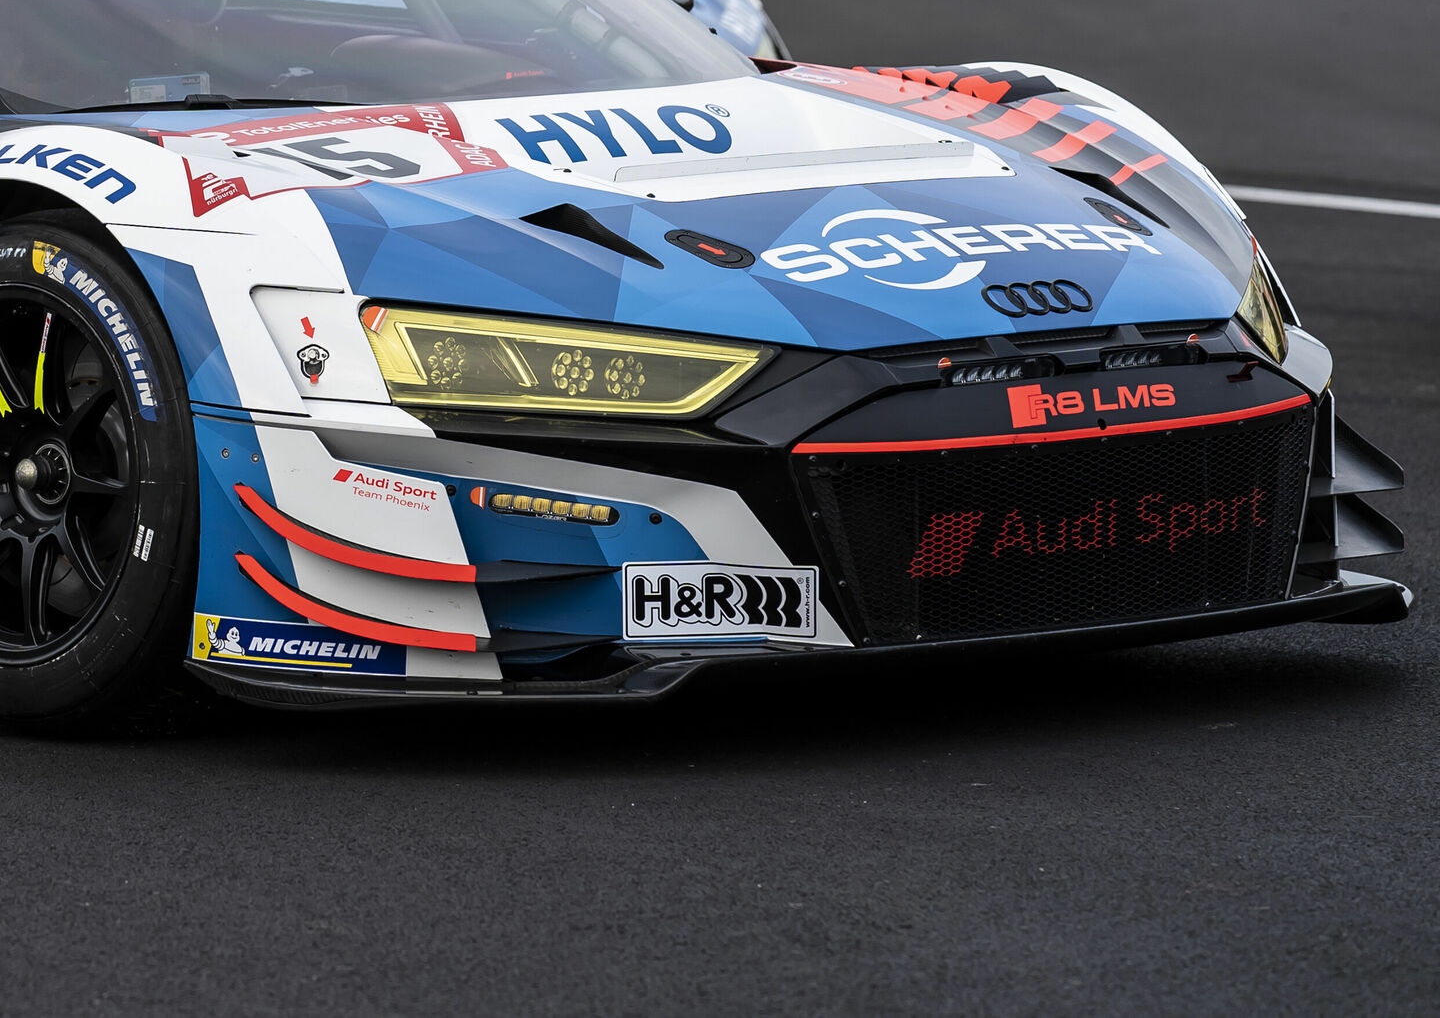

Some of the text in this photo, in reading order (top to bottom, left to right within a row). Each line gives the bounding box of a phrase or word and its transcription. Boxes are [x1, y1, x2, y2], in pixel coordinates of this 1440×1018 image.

[760, 221, 1163, 284] SCHERER
[68, 270, 155, 408] MICHELIN
[1027, 383, 1177, 420] R8 LMS
[352, 486, 431, 512] Team Phoenix
[353, 472, 438, 501] Audi Sport
[990, 487, 1267, 558] Audi Sport
[632, 573, 745, 627] H&R
[247, 635, 382, 661] MICHELIN
